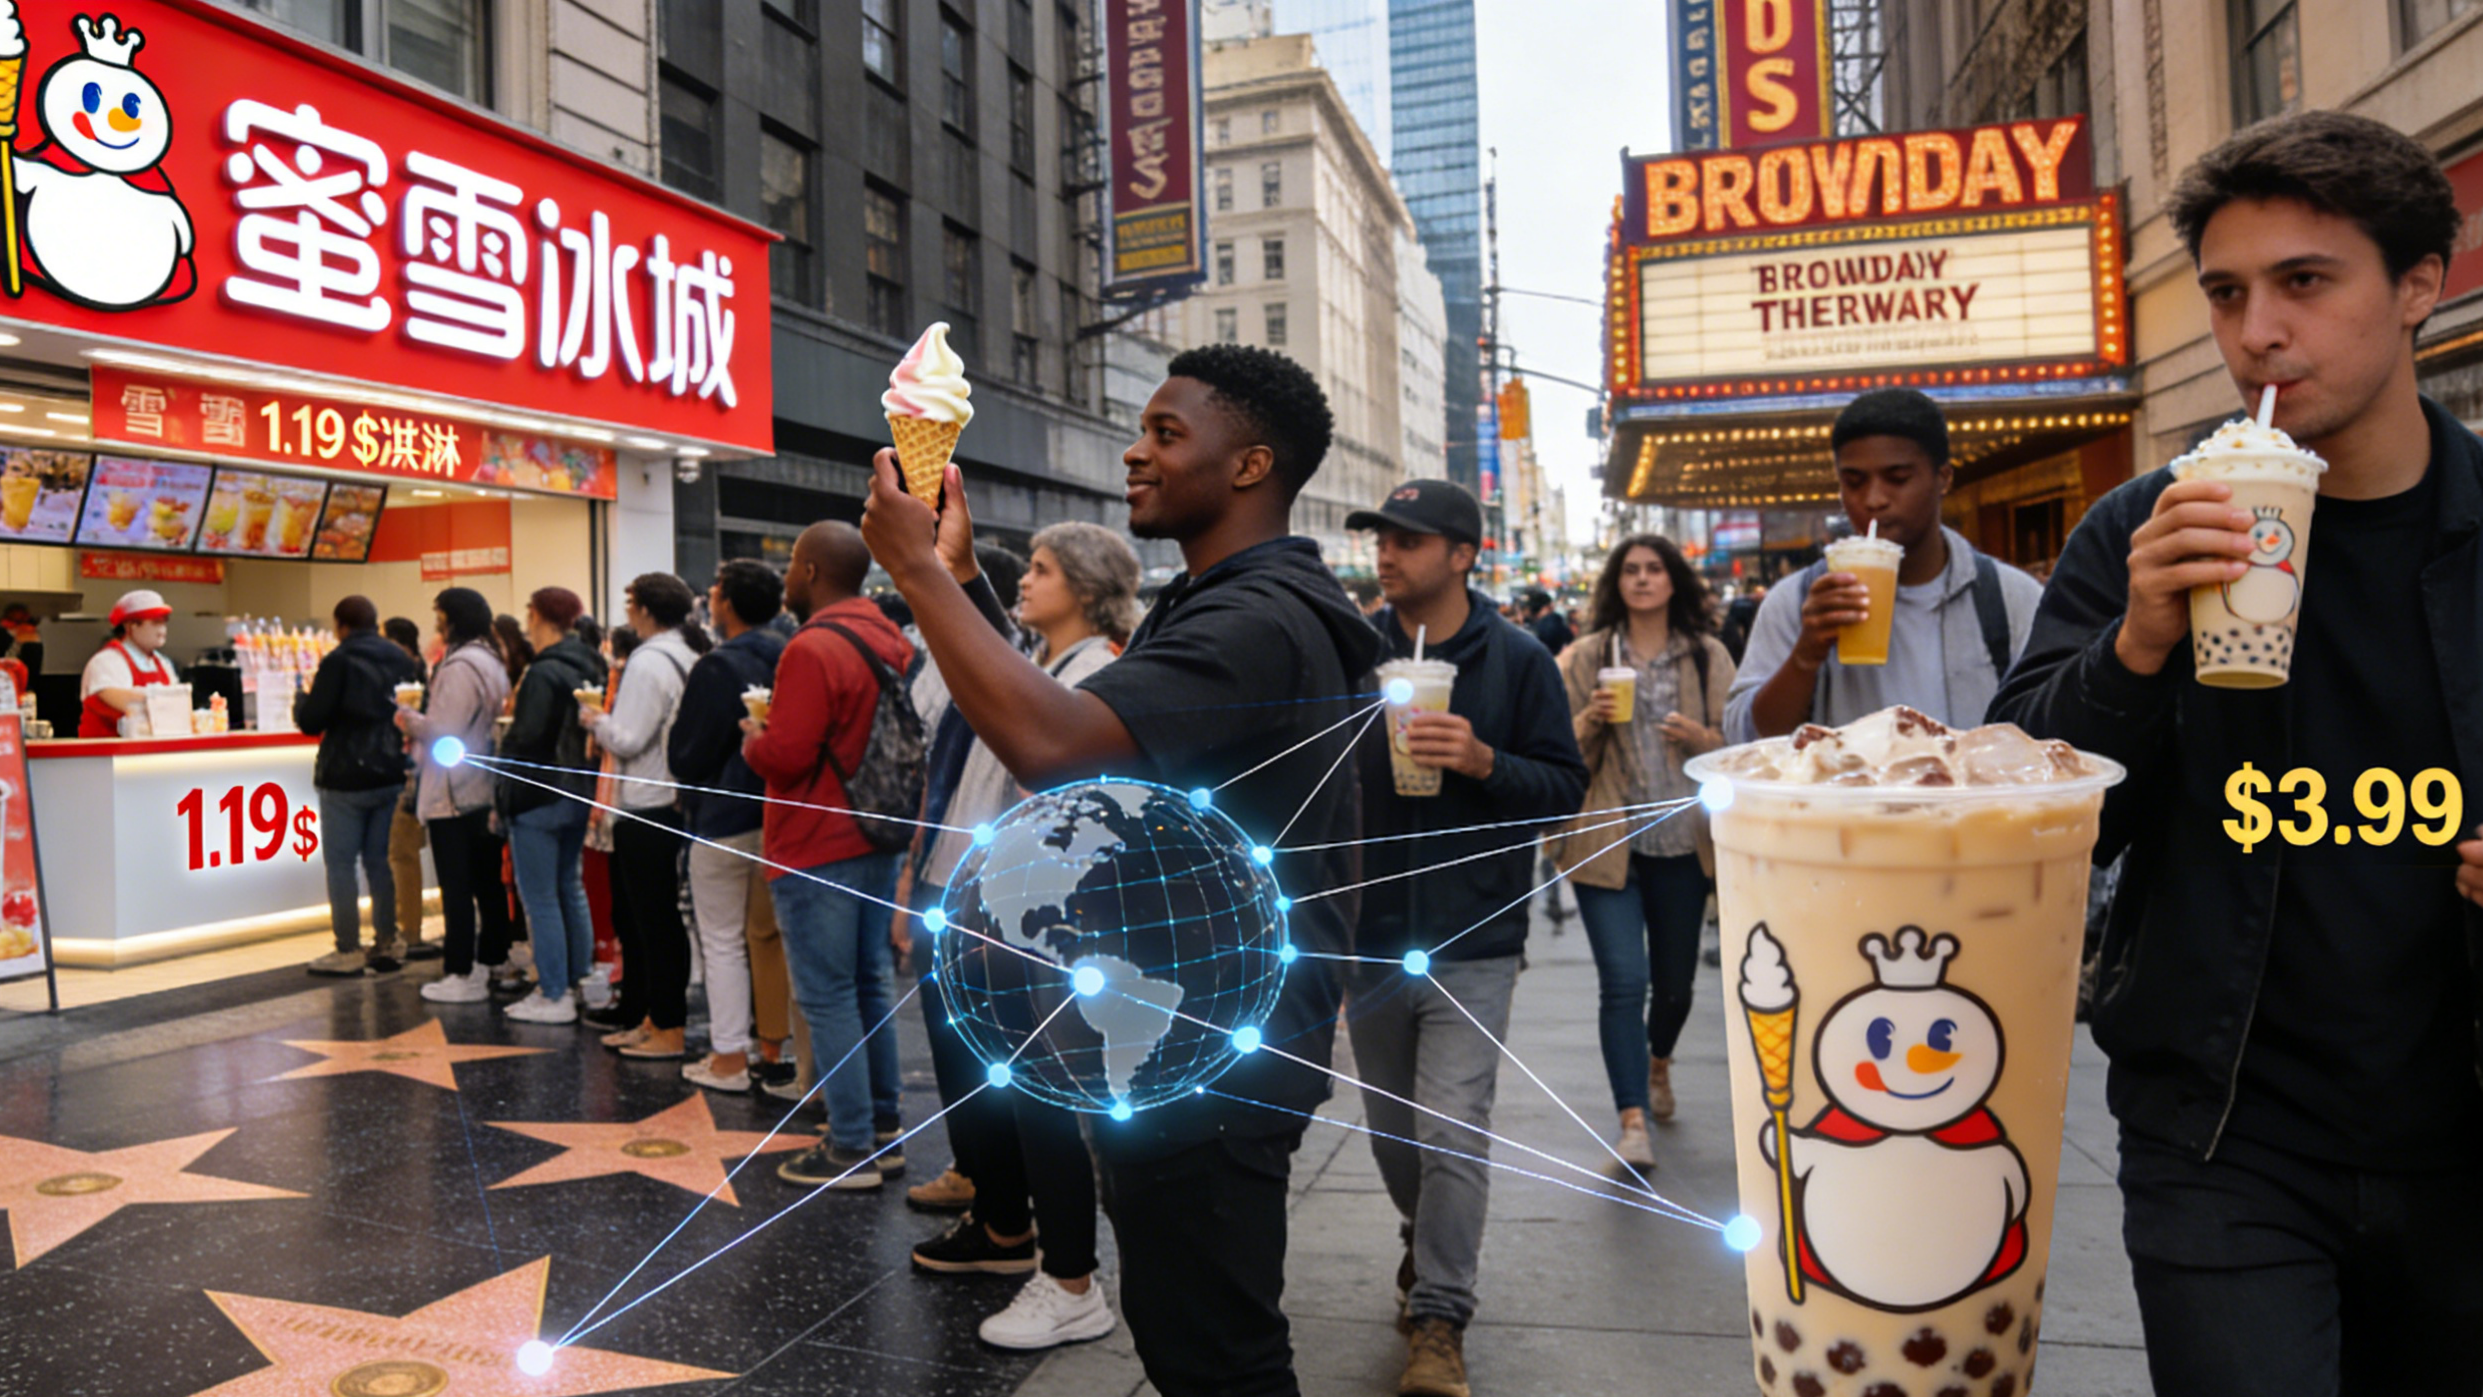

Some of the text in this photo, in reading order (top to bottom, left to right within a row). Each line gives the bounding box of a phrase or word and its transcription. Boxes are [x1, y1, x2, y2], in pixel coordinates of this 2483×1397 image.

[226, 98, 738, 408] 蜜雪冰城
[1751, 283, 1980, 332] THERWARY
[177, 782, 319, 871] 1.19$
